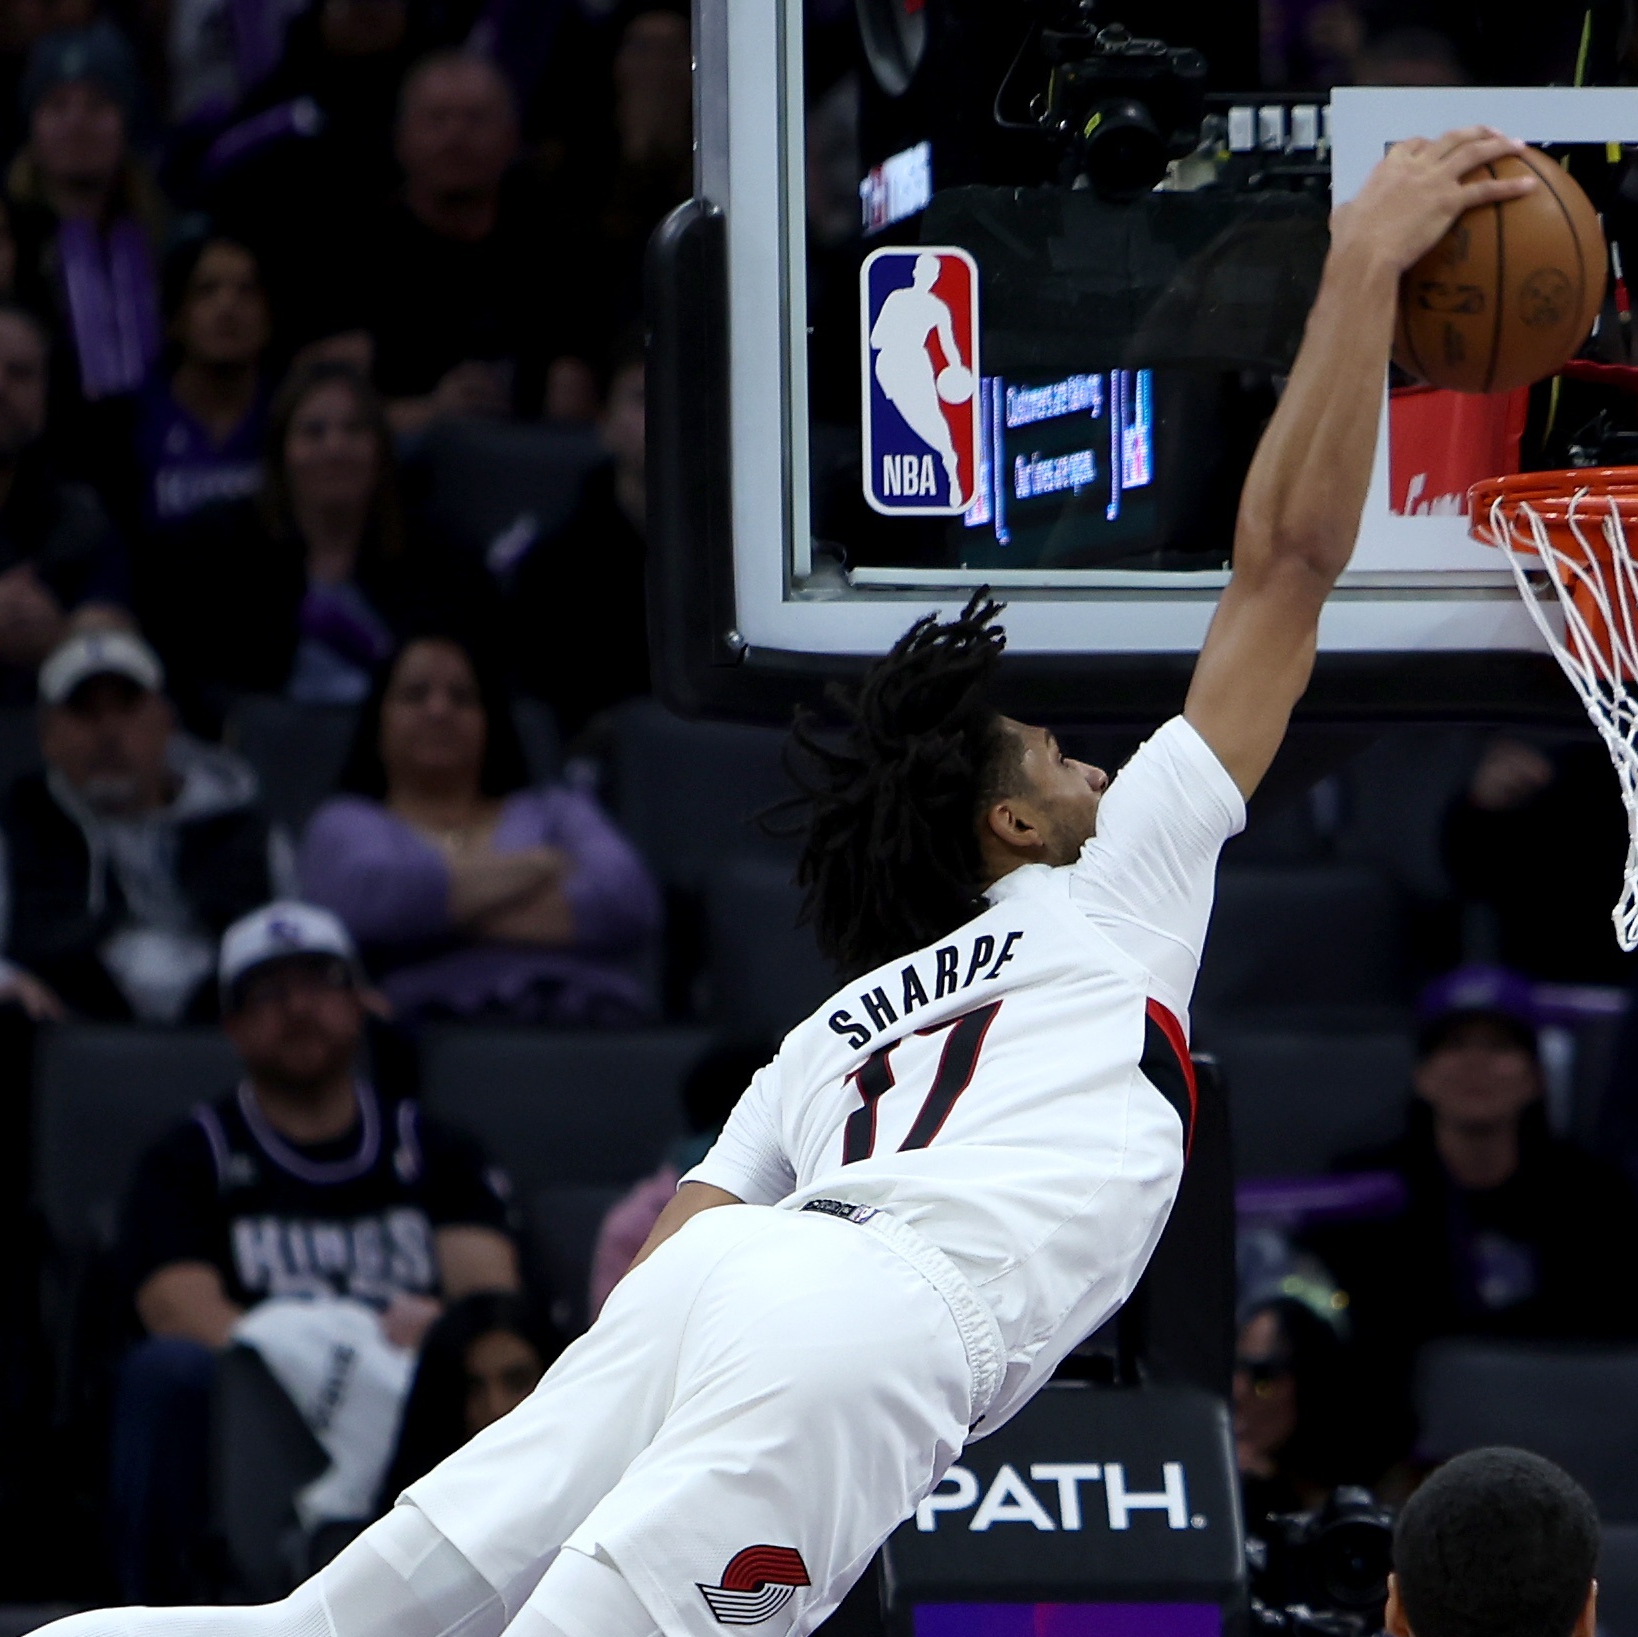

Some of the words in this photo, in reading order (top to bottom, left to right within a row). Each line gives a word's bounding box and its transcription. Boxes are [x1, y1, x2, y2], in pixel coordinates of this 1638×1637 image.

[882, 453, 937, 497] NBA
[828, 930, 1024, 1051] SHARPE
[842, 1000, 1003, 1166] 17
